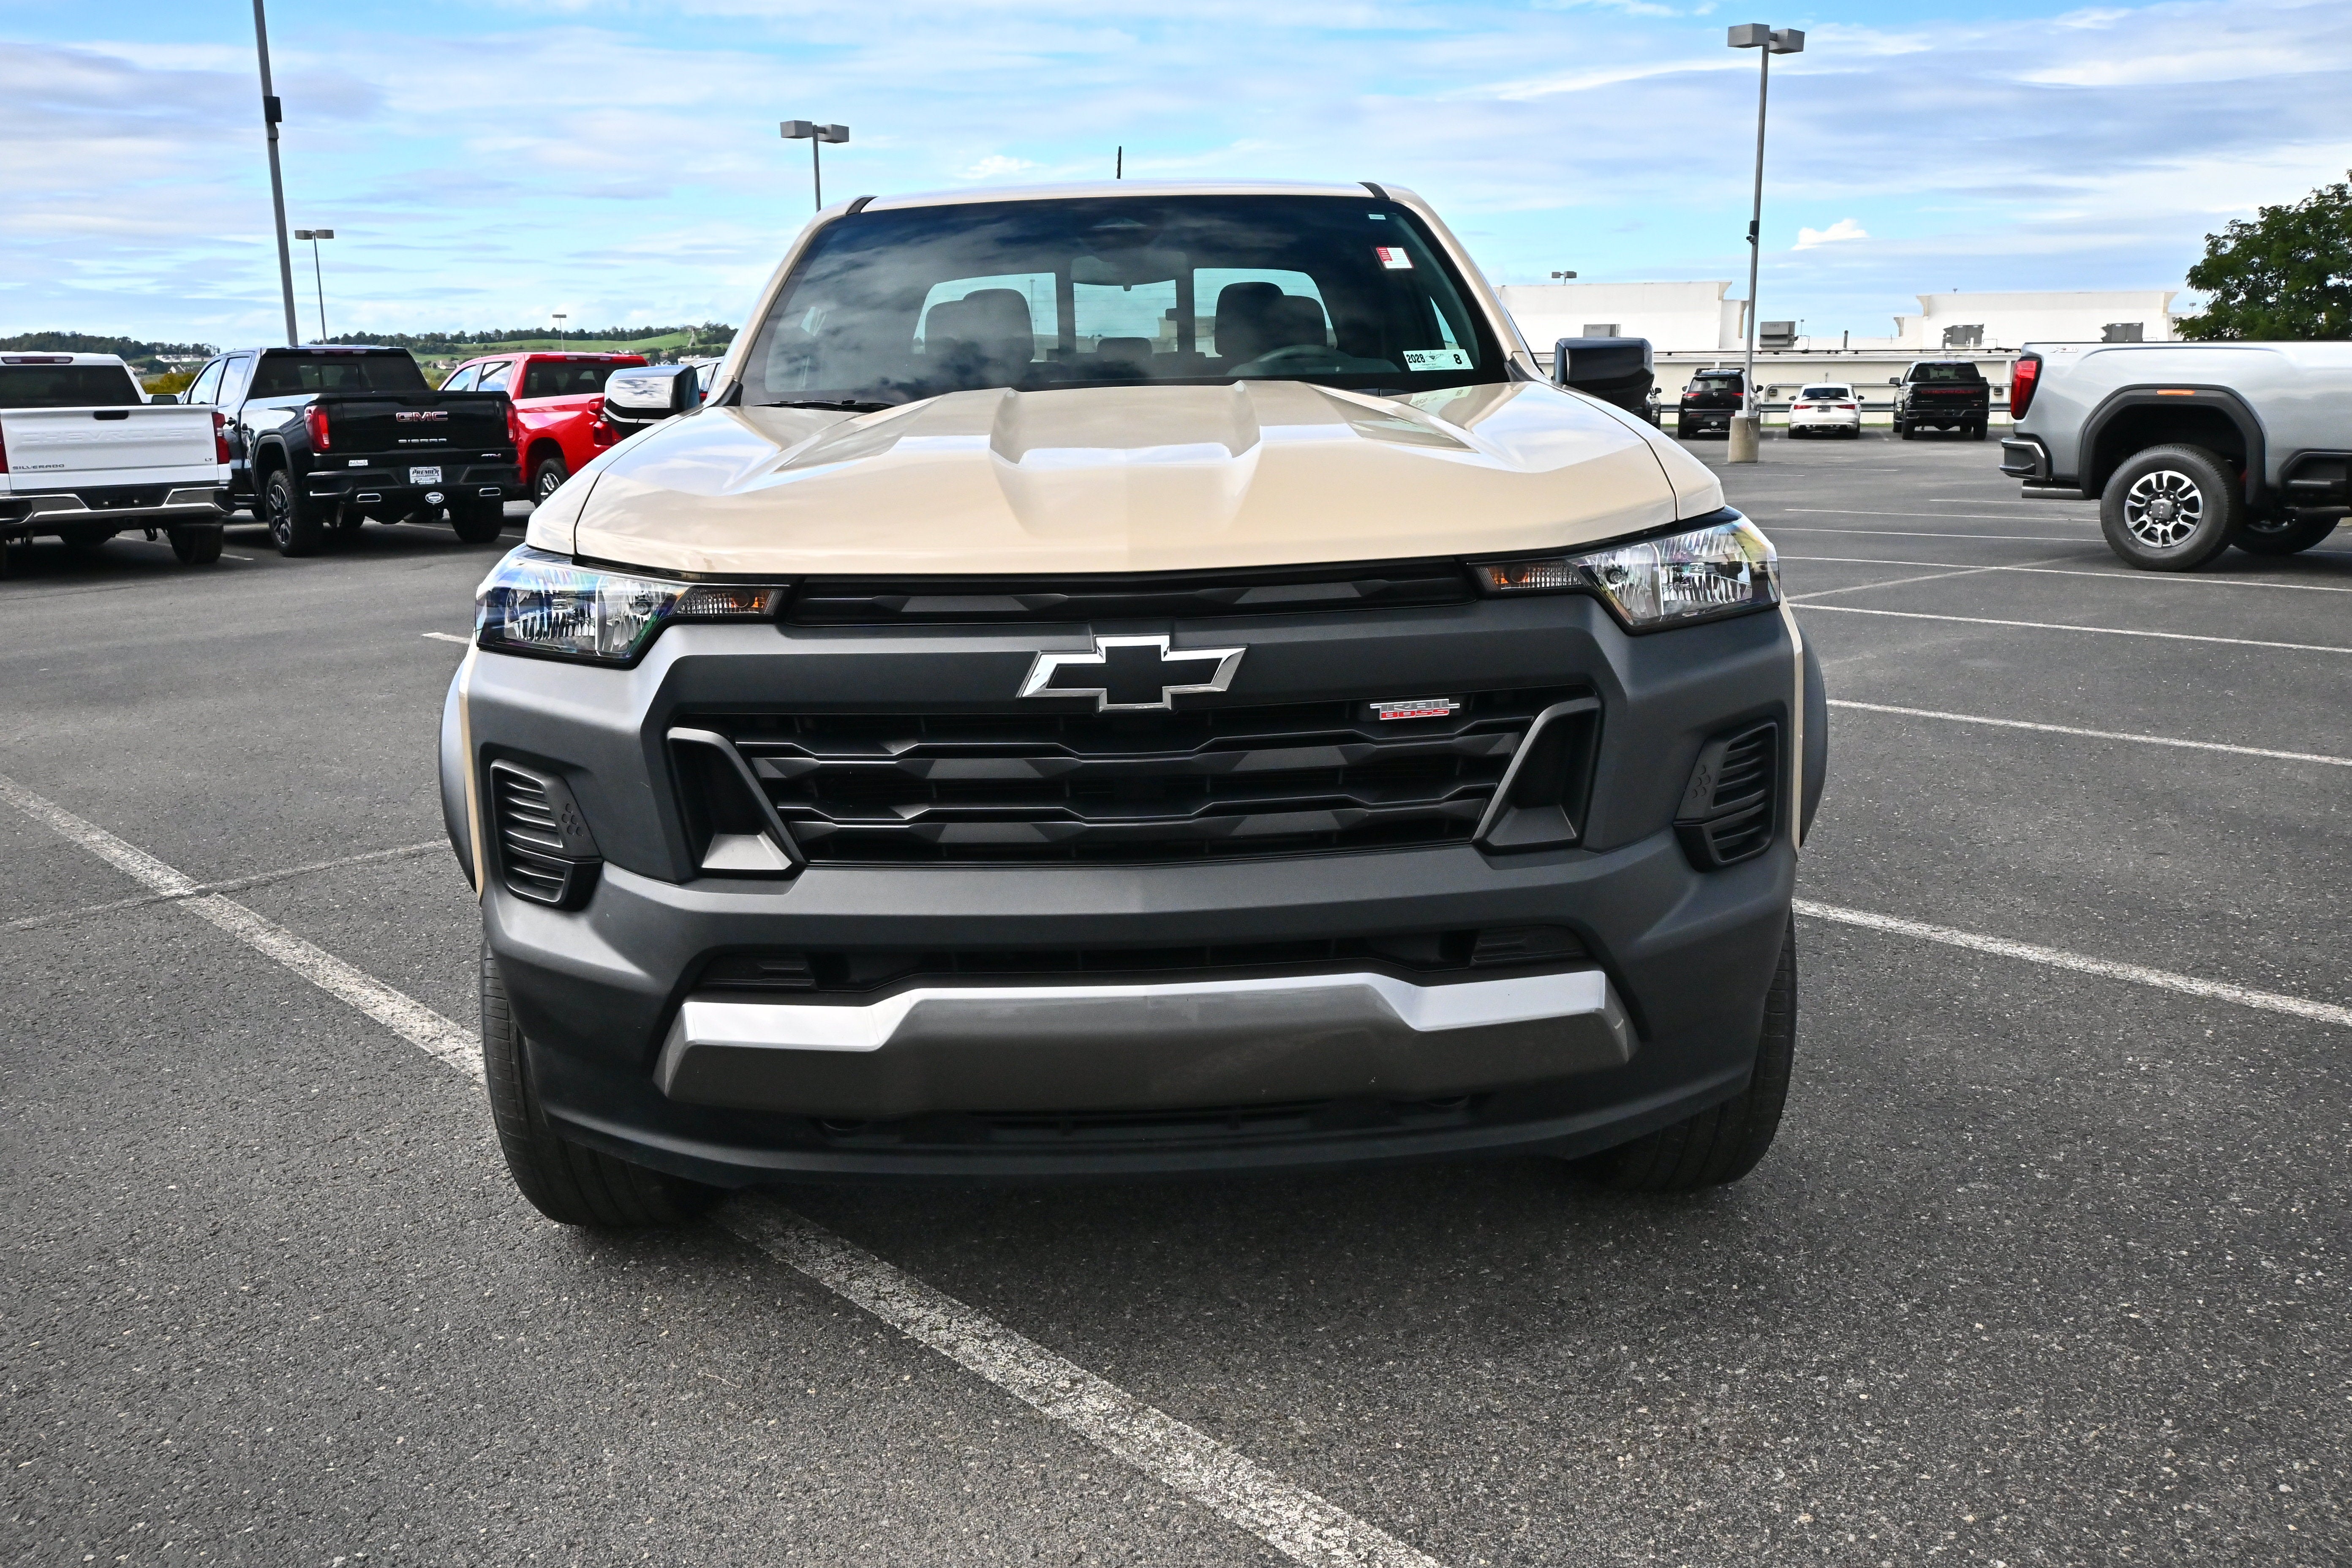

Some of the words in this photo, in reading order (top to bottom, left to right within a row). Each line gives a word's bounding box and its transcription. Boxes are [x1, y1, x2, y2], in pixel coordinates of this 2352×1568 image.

[1406, 354, 1426, 363] 2028
[1453, 354, 1462, 365] 8
[396, 411, 448, 422] GMC
[1370, 699, 1460, 712] TRAIL
[1380, 708, 1449, 720] BOSS
